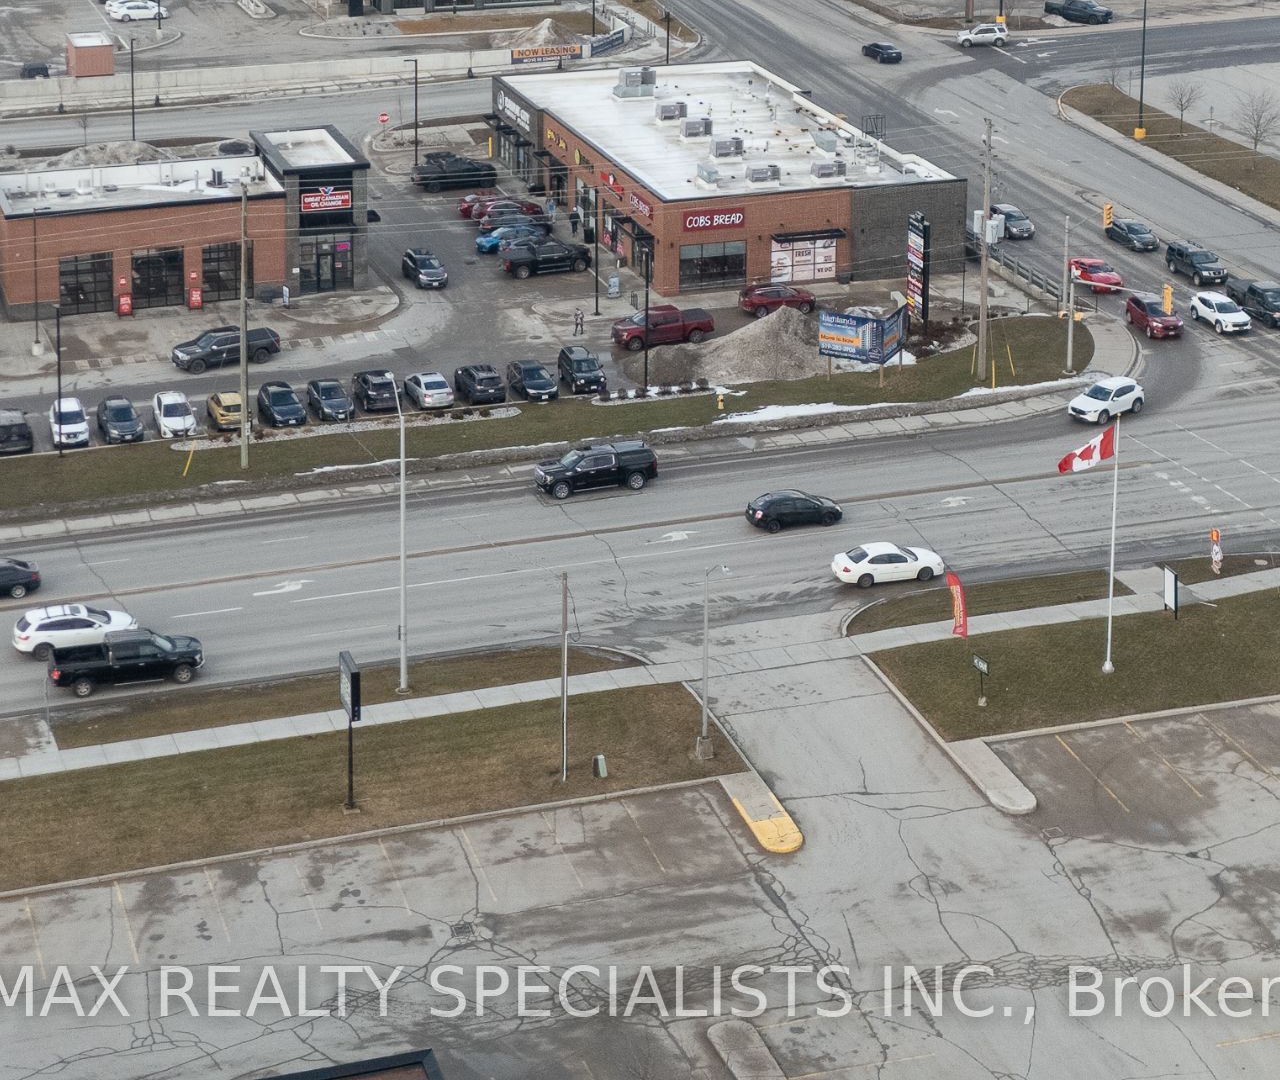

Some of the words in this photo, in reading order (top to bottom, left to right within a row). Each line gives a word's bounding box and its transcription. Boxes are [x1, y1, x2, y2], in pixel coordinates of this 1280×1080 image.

[518, 48, 539, 58] NOW
[541, 46, 577, 56] LEASING
[686, 215, 711, 228] COBS
[713, 213, 743, 226] BREAD
